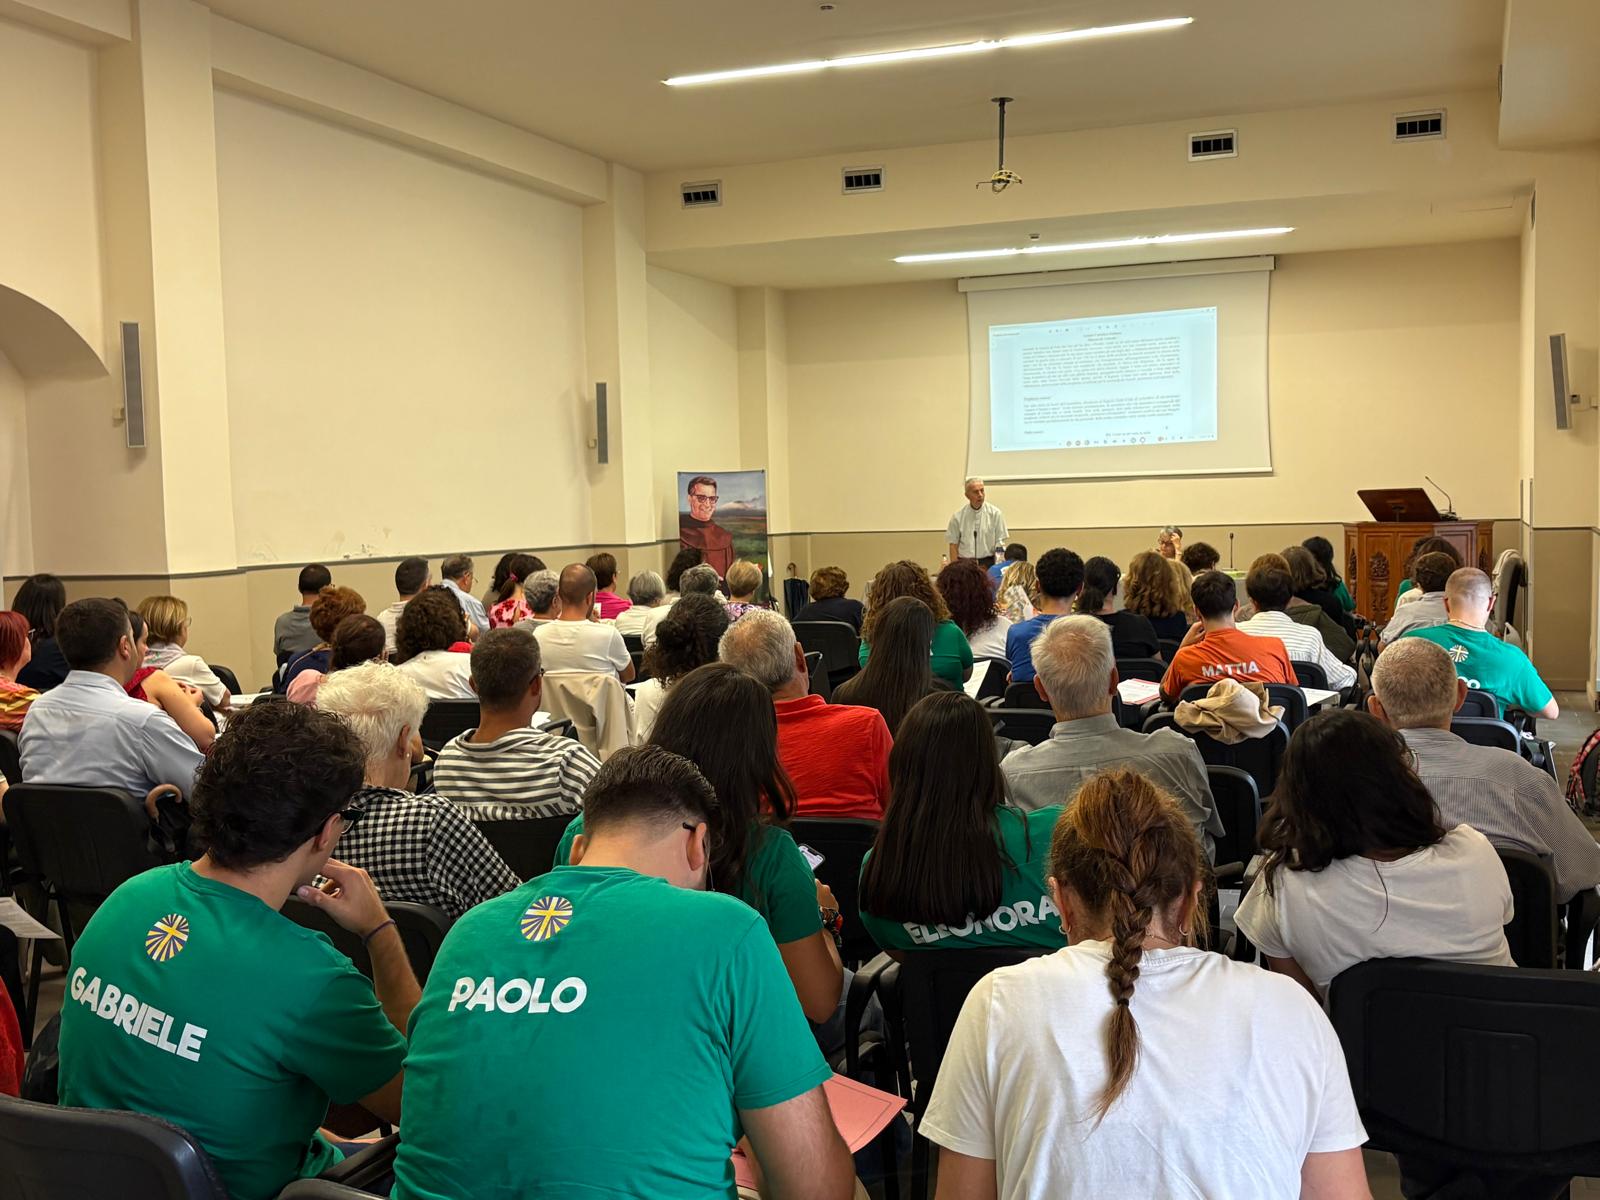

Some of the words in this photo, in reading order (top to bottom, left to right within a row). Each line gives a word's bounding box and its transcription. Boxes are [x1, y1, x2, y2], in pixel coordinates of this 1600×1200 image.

[1201, 661, 1260, 677] MATTIA
[70, 966, 208, 1062] GABRIELE
[447, 976, 588, 1014] PAOLO
